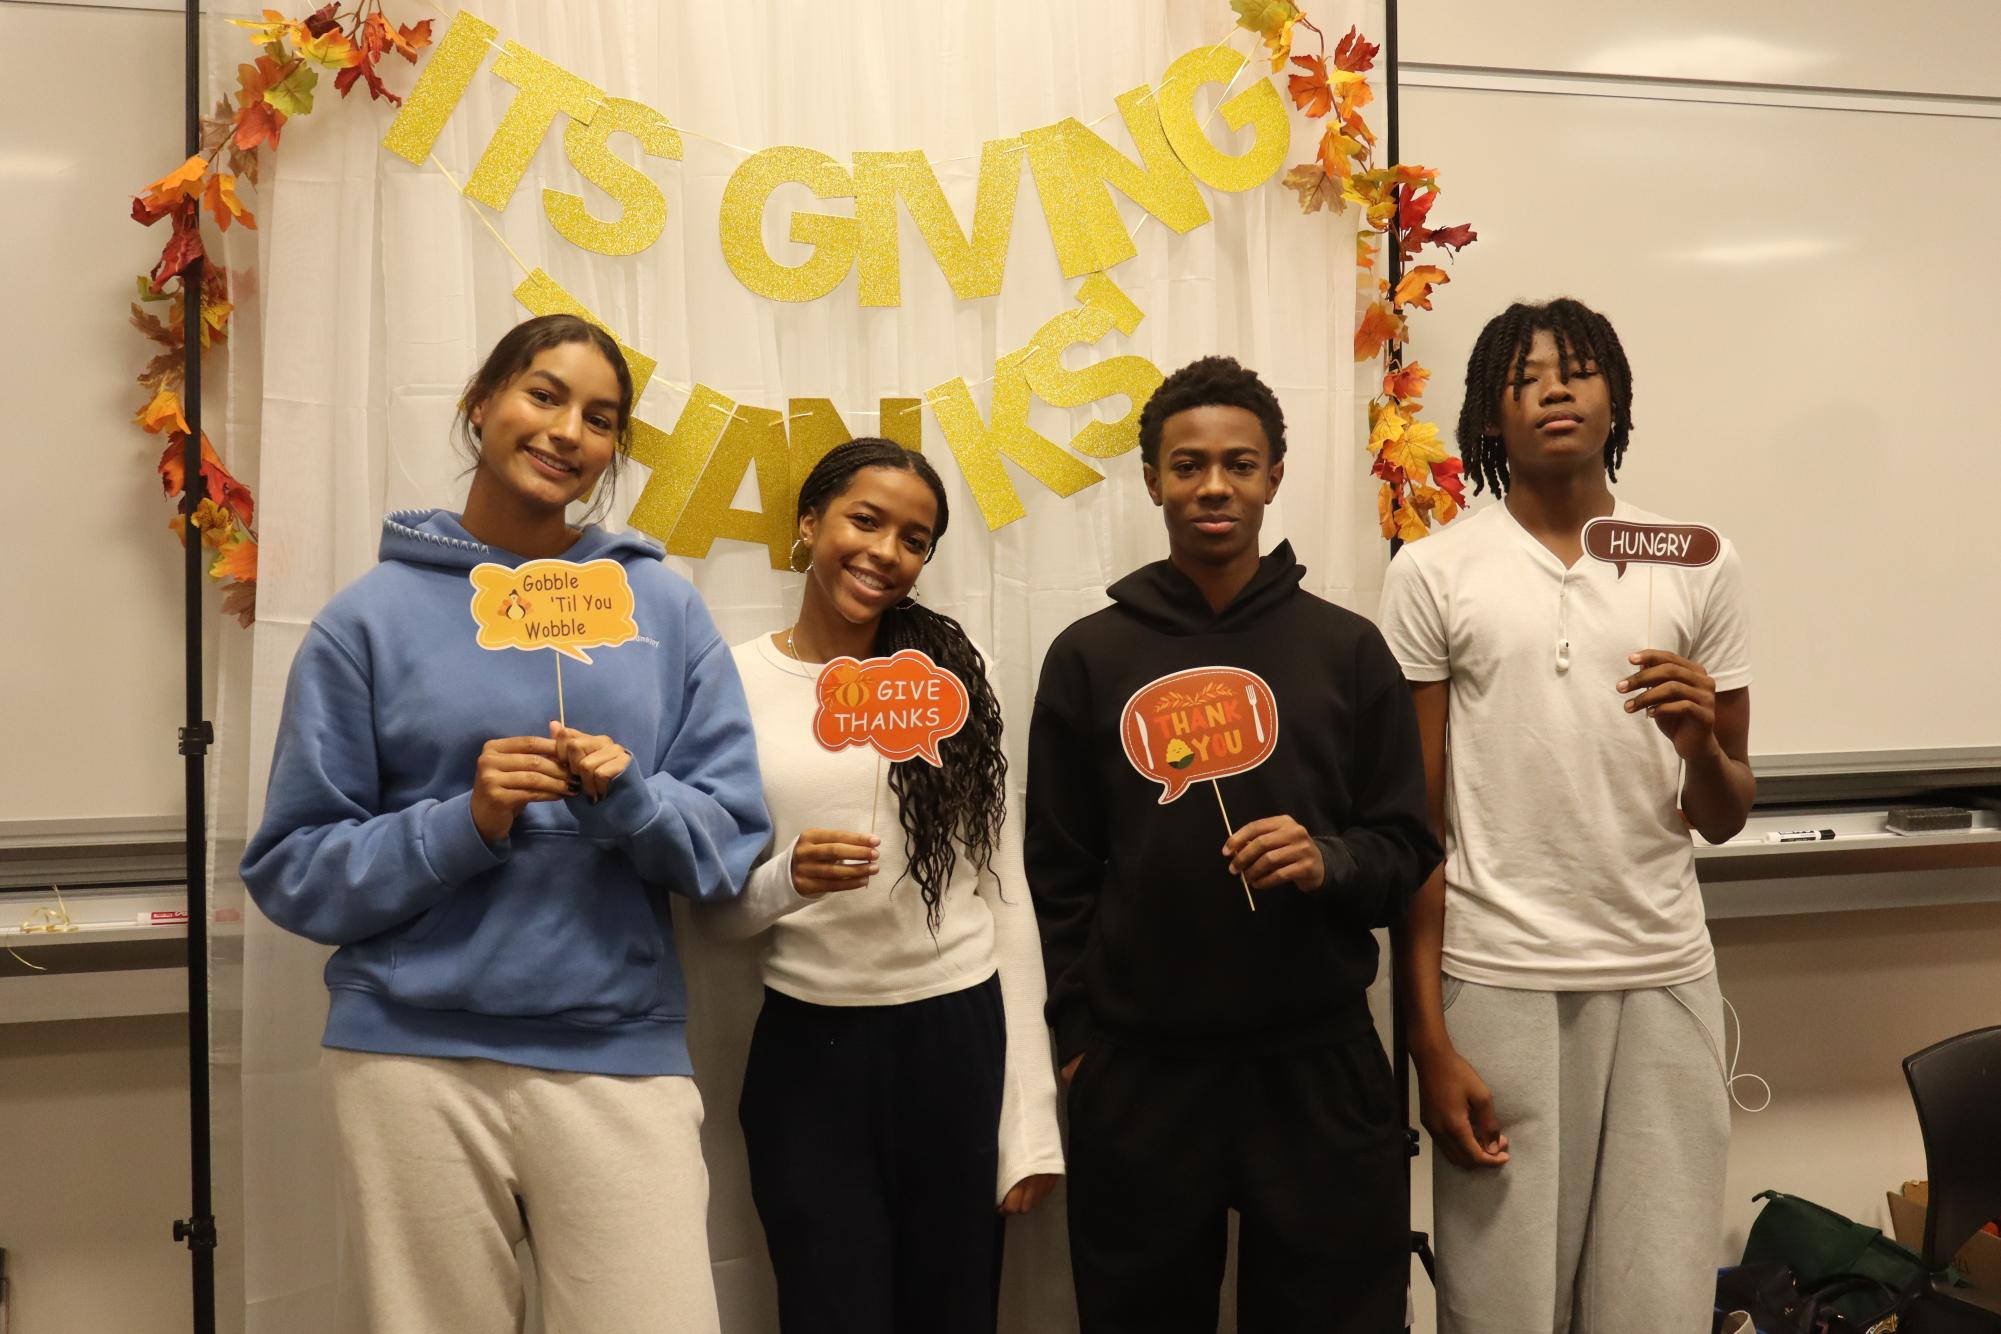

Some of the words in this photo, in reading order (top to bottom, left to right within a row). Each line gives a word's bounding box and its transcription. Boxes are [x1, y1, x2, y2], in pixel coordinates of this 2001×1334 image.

[384, 9, 683, 257] ITS
[719, 44, 1292, 307] GIVING
[1610, 530, 1692, 558] HUNGRY
[523, 571, 579, 592] Gobble
[582, 594, 613, 611] You
[525, 618, 586, 641] Wobble
[877, 679, 941, 701] GIVE
[834, 707, 941, 733] THANKS
[1153, 699, 1242, 739] THANK
[1191, 729, 1244, 762] YOU
